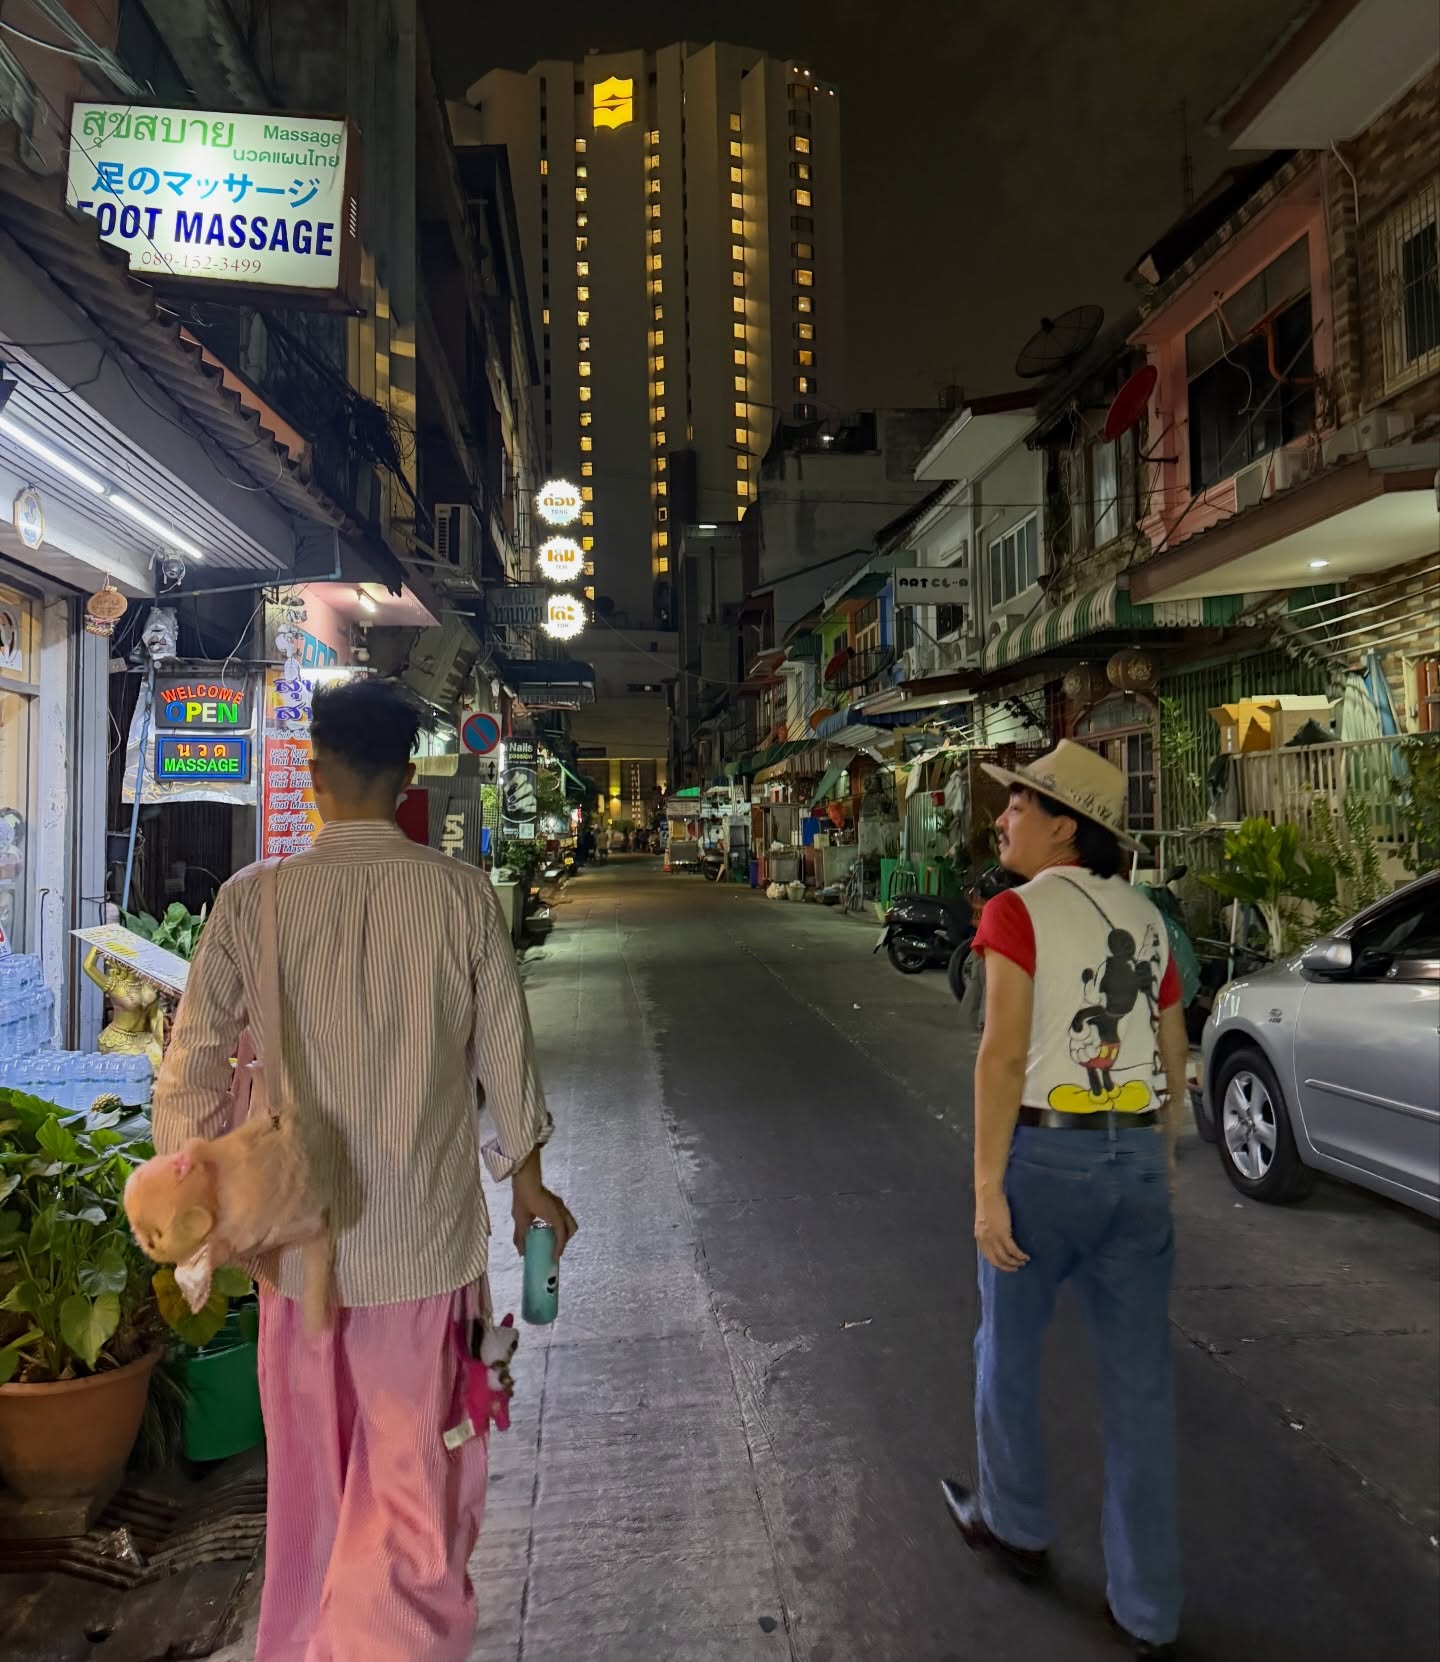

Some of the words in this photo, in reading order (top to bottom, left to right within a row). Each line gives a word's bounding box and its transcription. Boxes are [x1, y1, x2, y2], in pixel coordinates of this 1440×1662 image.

[82, 110, 235, 148] สุขสบาย
[263, 125, 342, 147] Massage
[232, 147, 341, 169] นวดแผนไทย
[91, 161, 321, 209] 足のマッサージ
[173, 210, 335, 257] MASSAGE
[141, 250, 263, 275] 089-152-3499
[160, 684, 245, 704] WELCOME
[165, 701, 238, 724] OPEN
[508, 742, 533, 754] Nails
[163, 758, 239, 772] MASSAGE
[269, 801, 289, 810] Foot
[268, 823, 288, 832] Foot
[291, 822, 315, 832] Scrub
[268, 846, 281, 854] Oil
